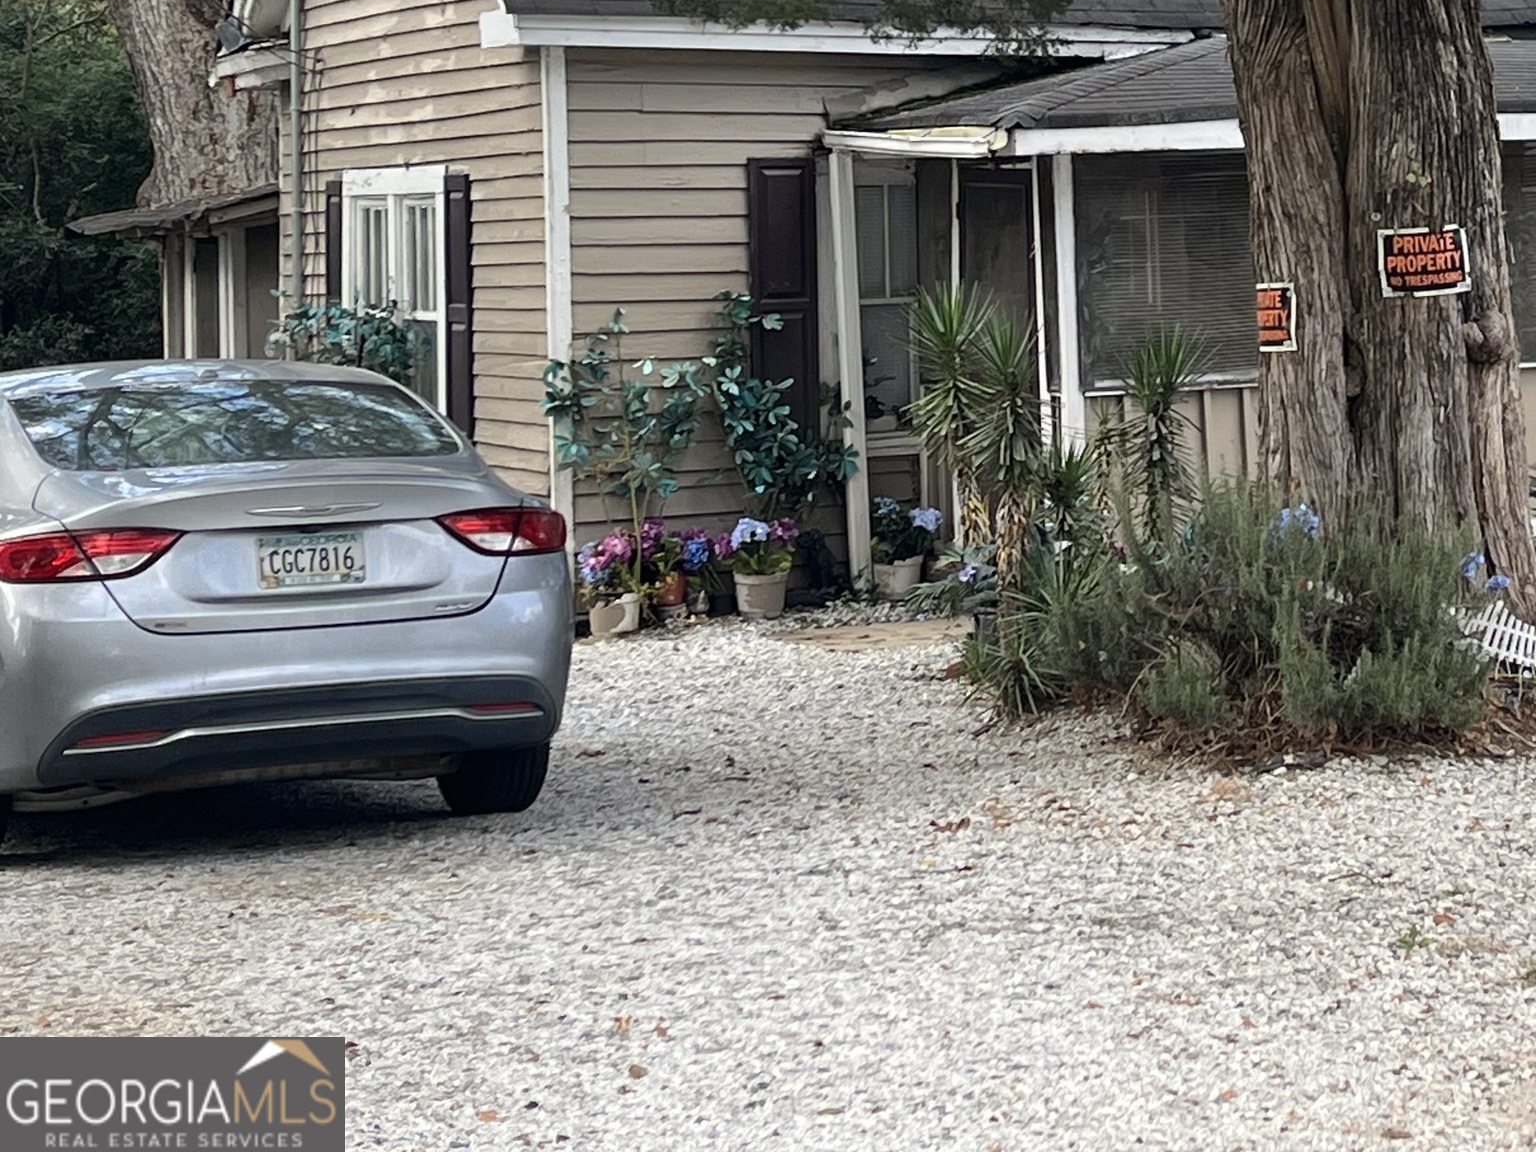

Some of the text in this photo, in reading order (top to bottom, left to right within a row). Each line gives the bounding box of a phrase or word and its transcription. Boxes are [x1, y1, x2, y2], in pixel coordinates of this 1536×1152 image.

[1392, 232, 1455, 254] PRIVATE
[1386, 250, 1462, 273] PROPERTY
[1405, 270, 1463, 286] TRESPASSING
[269, 546, 354, 574] CGC7816
